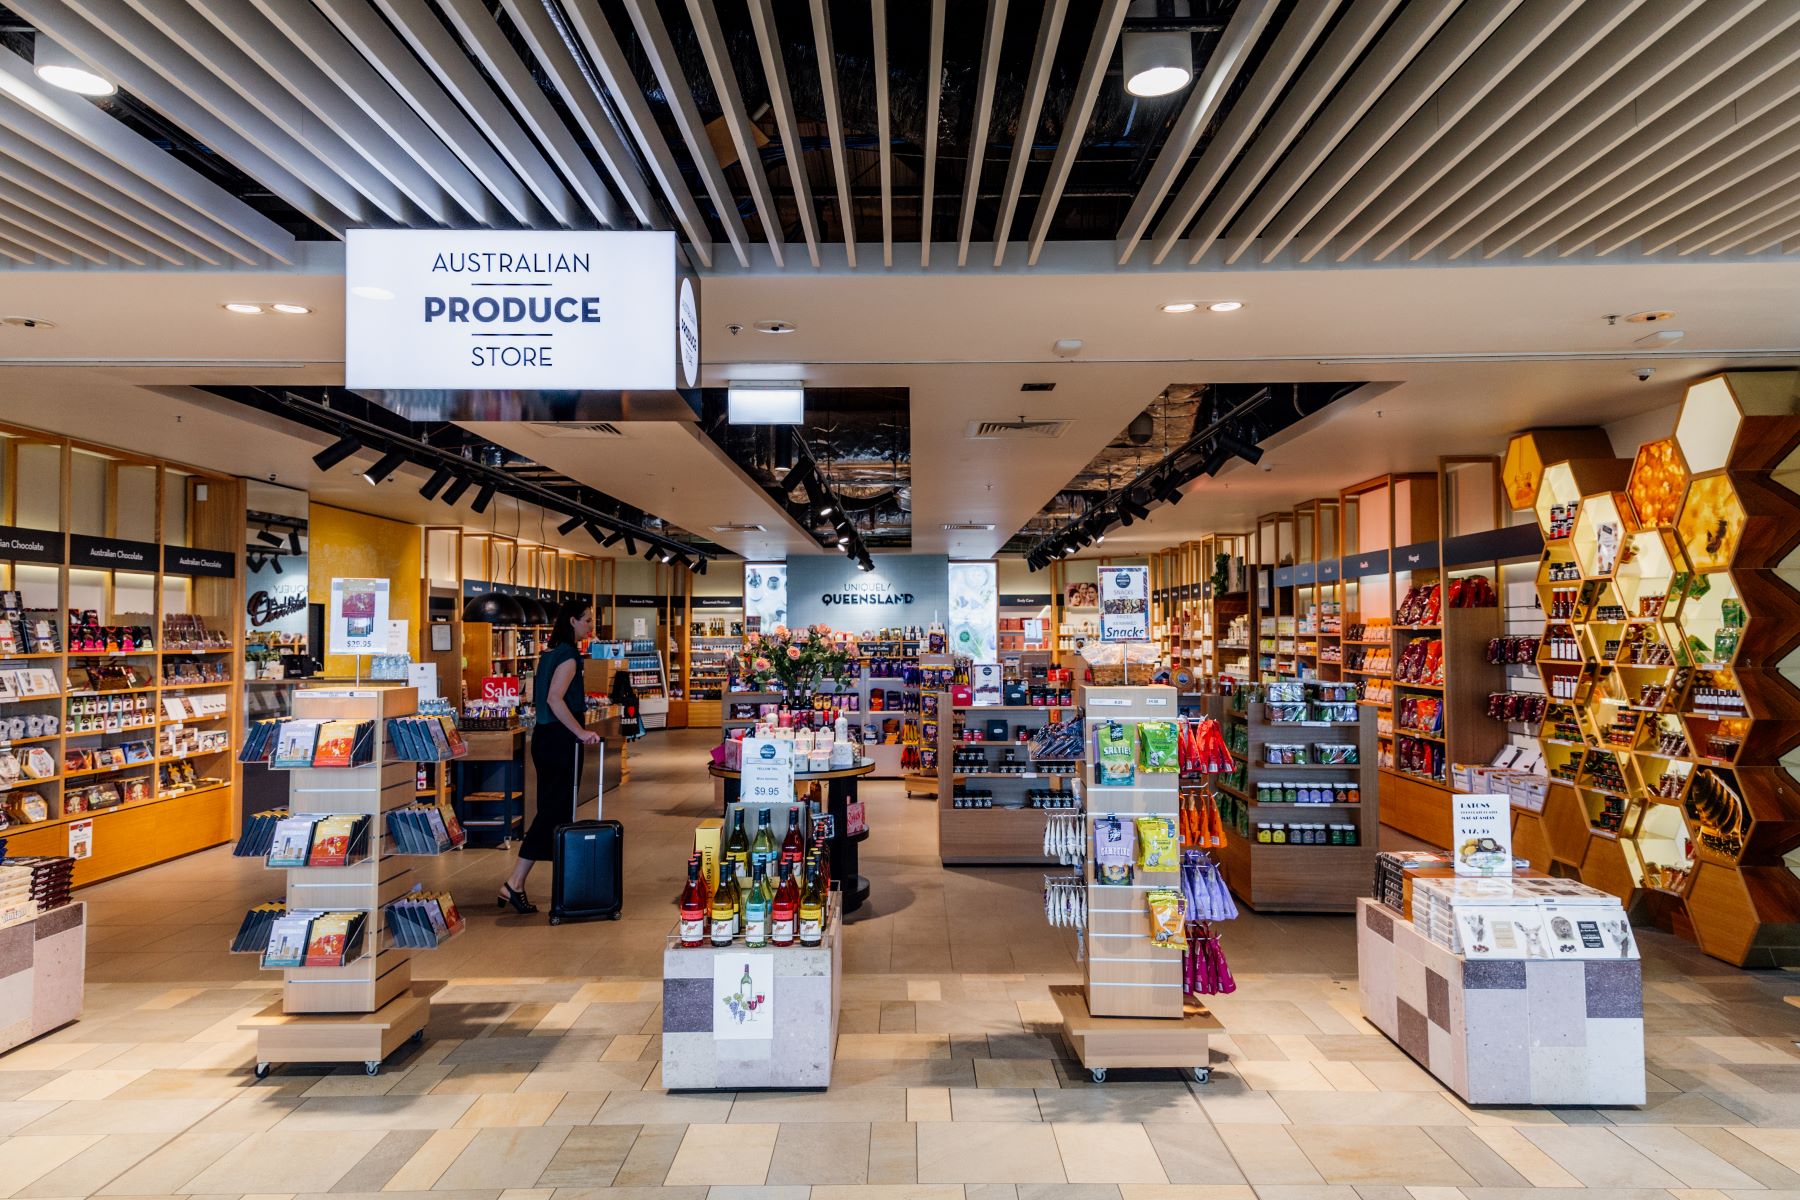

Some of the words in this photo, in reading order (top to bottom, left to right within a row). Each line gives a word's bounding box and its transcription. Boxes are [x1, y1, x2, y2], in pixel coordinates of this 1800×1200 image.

[432, 253, 589, 272] AUSTRALIAN
[424, 297, 600, 323] PRODUCE
[471, 347, 552, 366] STORE
[12, 539, 44, 551] Chocolate
[90, 548, 116, 558] Australian
[117, 551, 144, 561] Chocolate
[179, 556, 201, 566] Australian
[201, 559, 222, 569] Chocolate
[821, 593, 915, 606] QUEENSLAND
[1106, 627, 1144, 638] Snacks
[484, 682, 517, 699] Sale
[754, 786, 780, 796] $9.95
